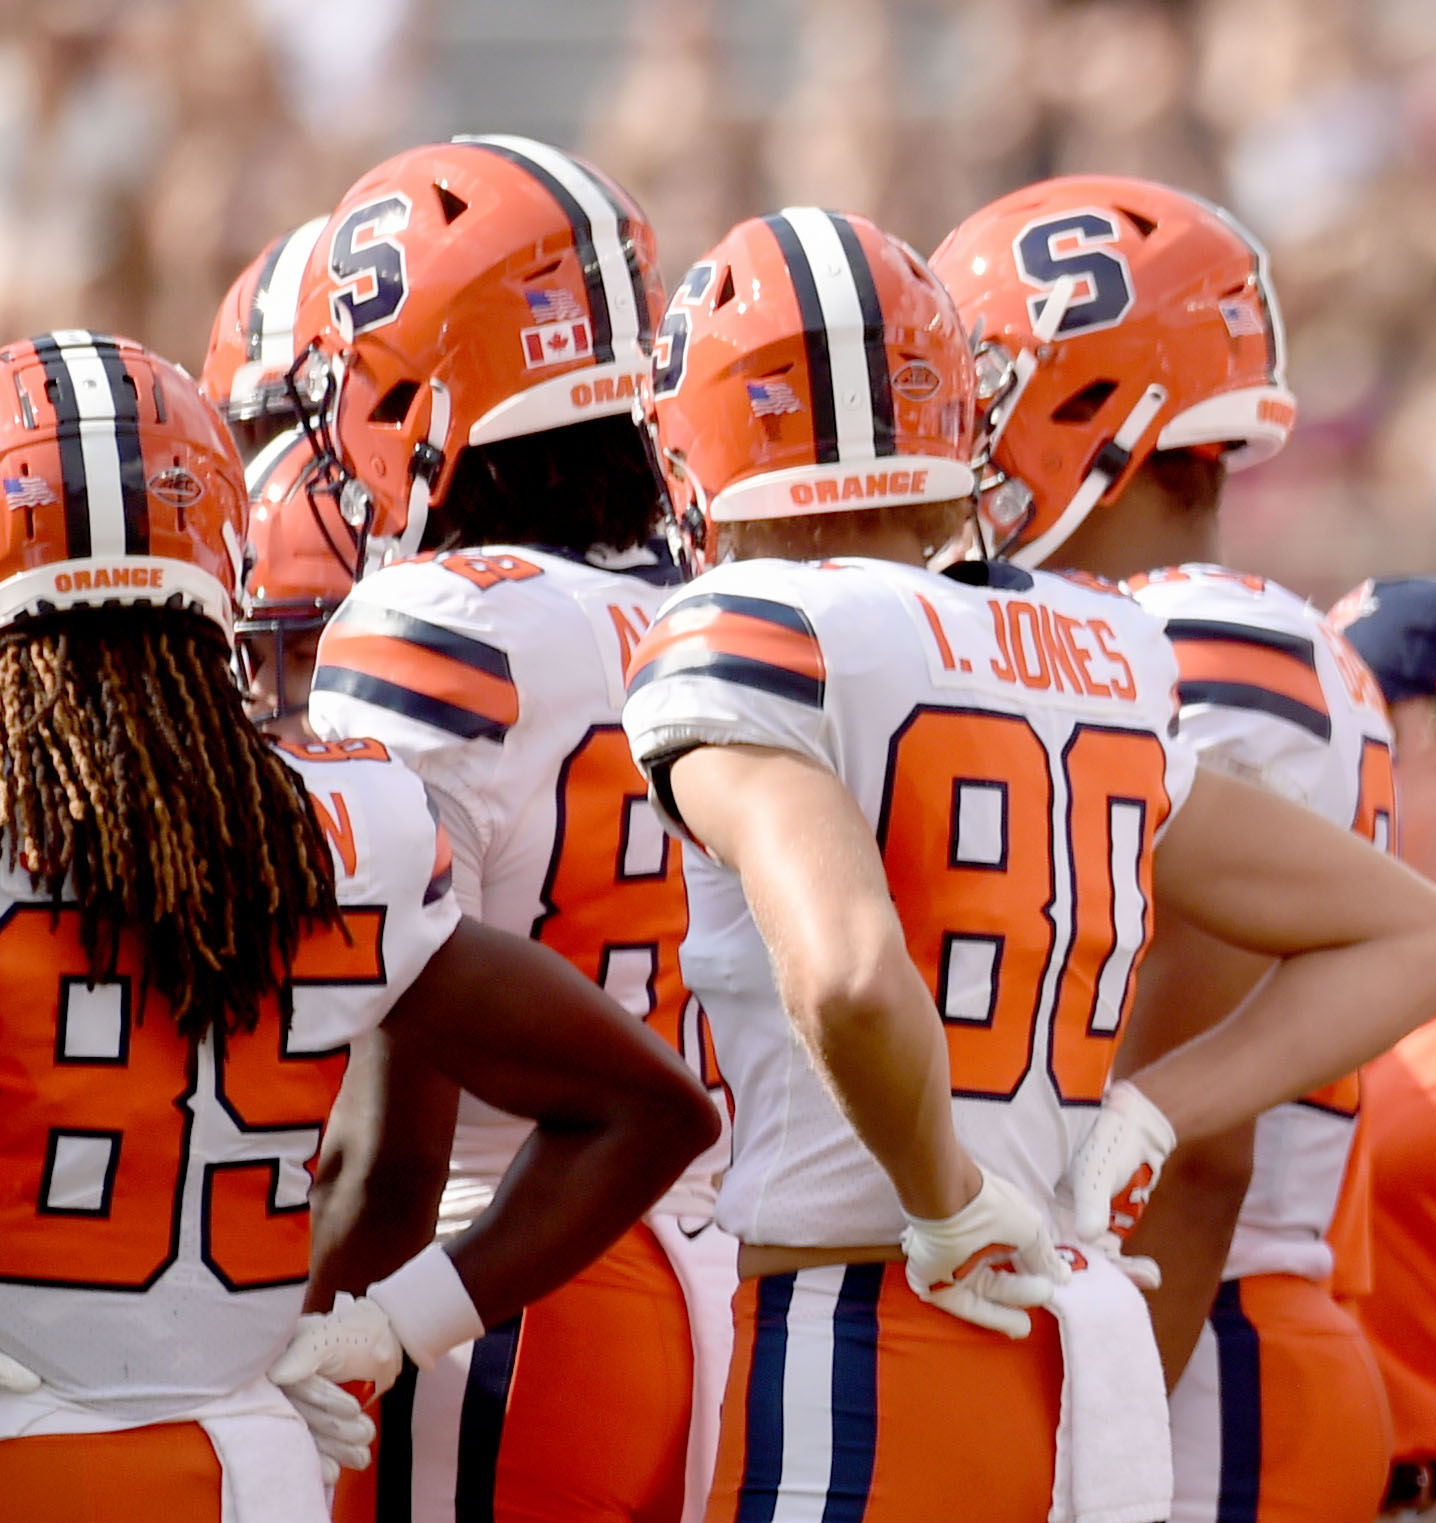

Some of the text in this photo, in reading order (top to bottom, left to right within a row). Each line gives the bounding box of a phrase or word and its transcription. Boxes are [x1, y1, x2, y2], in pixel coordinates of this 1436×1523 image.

[328, 191, 412, 338] S
[1012, 205, 1137, 341] S
[790, 469, 929, 507] ORANGE
[54, 567, 165, 594] ORANGE
[915, 592, 1137, 702] I. JONES
[876, 703, 1172, 1107] 80
[0, 901, 388, 1293] 85
